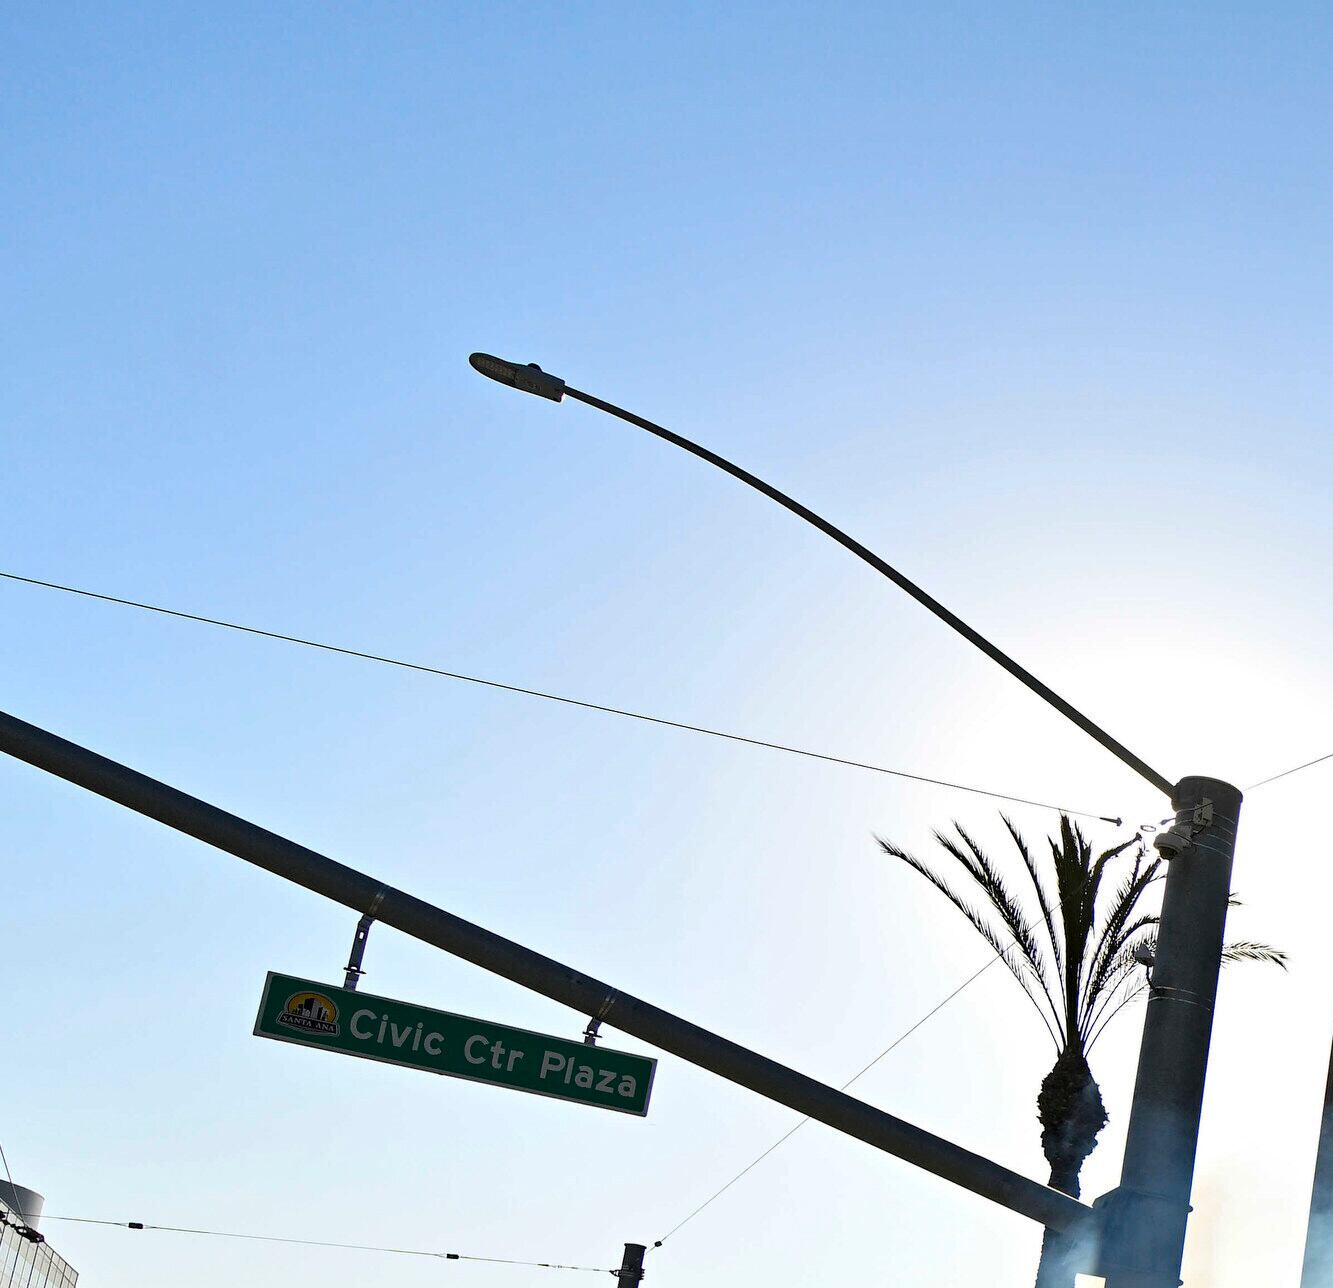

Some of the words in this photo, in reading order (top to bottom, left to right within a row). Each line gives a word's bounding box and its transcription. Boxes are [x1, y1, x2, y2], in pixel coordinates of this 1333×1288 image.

[282, 1015, 312, 1027] SANTA
[315, 1023, 335, 1032] ANA
[350, 1009, 445, 1055] Civic
[464, 1034, 525, 1072] Ctr
[539, 1050, 637, 1098] Plaza
